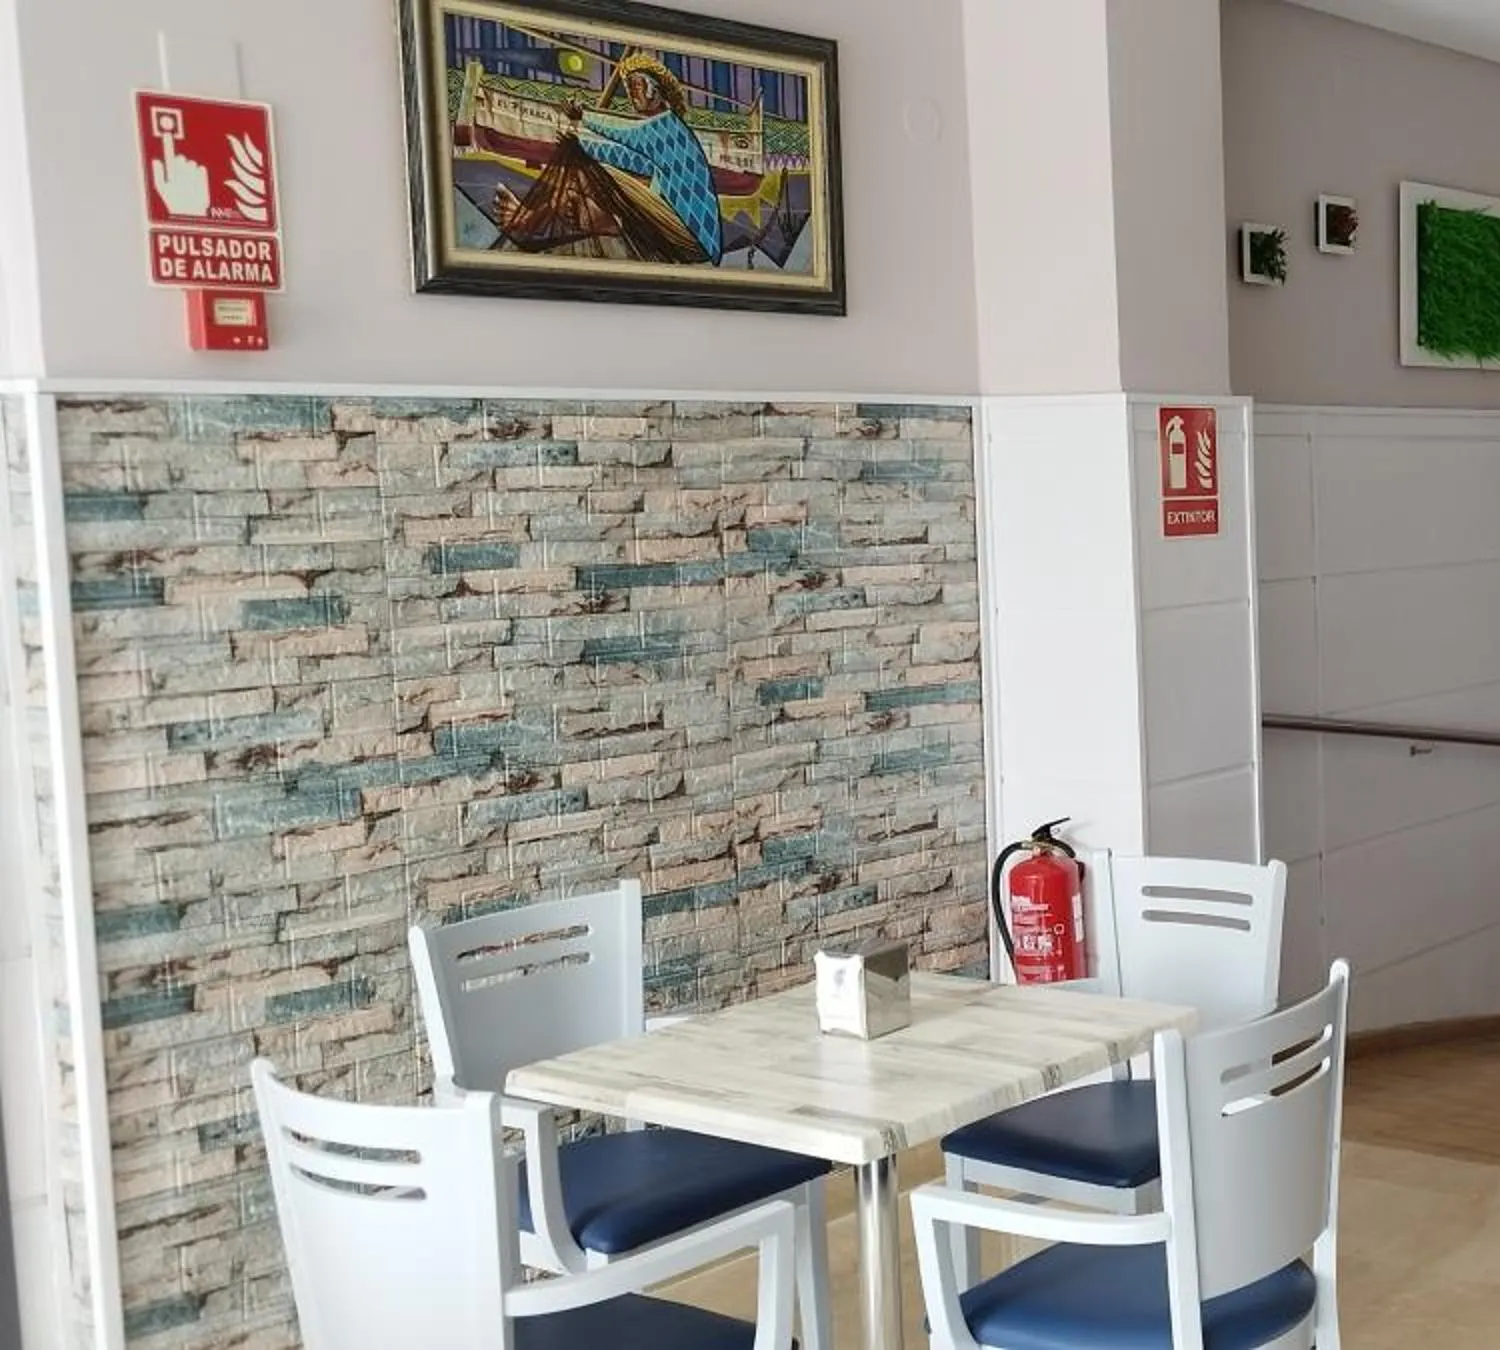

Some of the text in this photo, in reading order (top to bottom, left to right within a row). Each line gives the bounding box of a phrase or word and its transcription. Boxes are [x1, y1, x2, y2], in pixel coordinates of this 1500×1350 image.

[157, 234, 272, 260] PULSADOR
[160, 257, 274, 283] DE ALARMA
[1167, 509, 1216, 525] EXTINTOR
